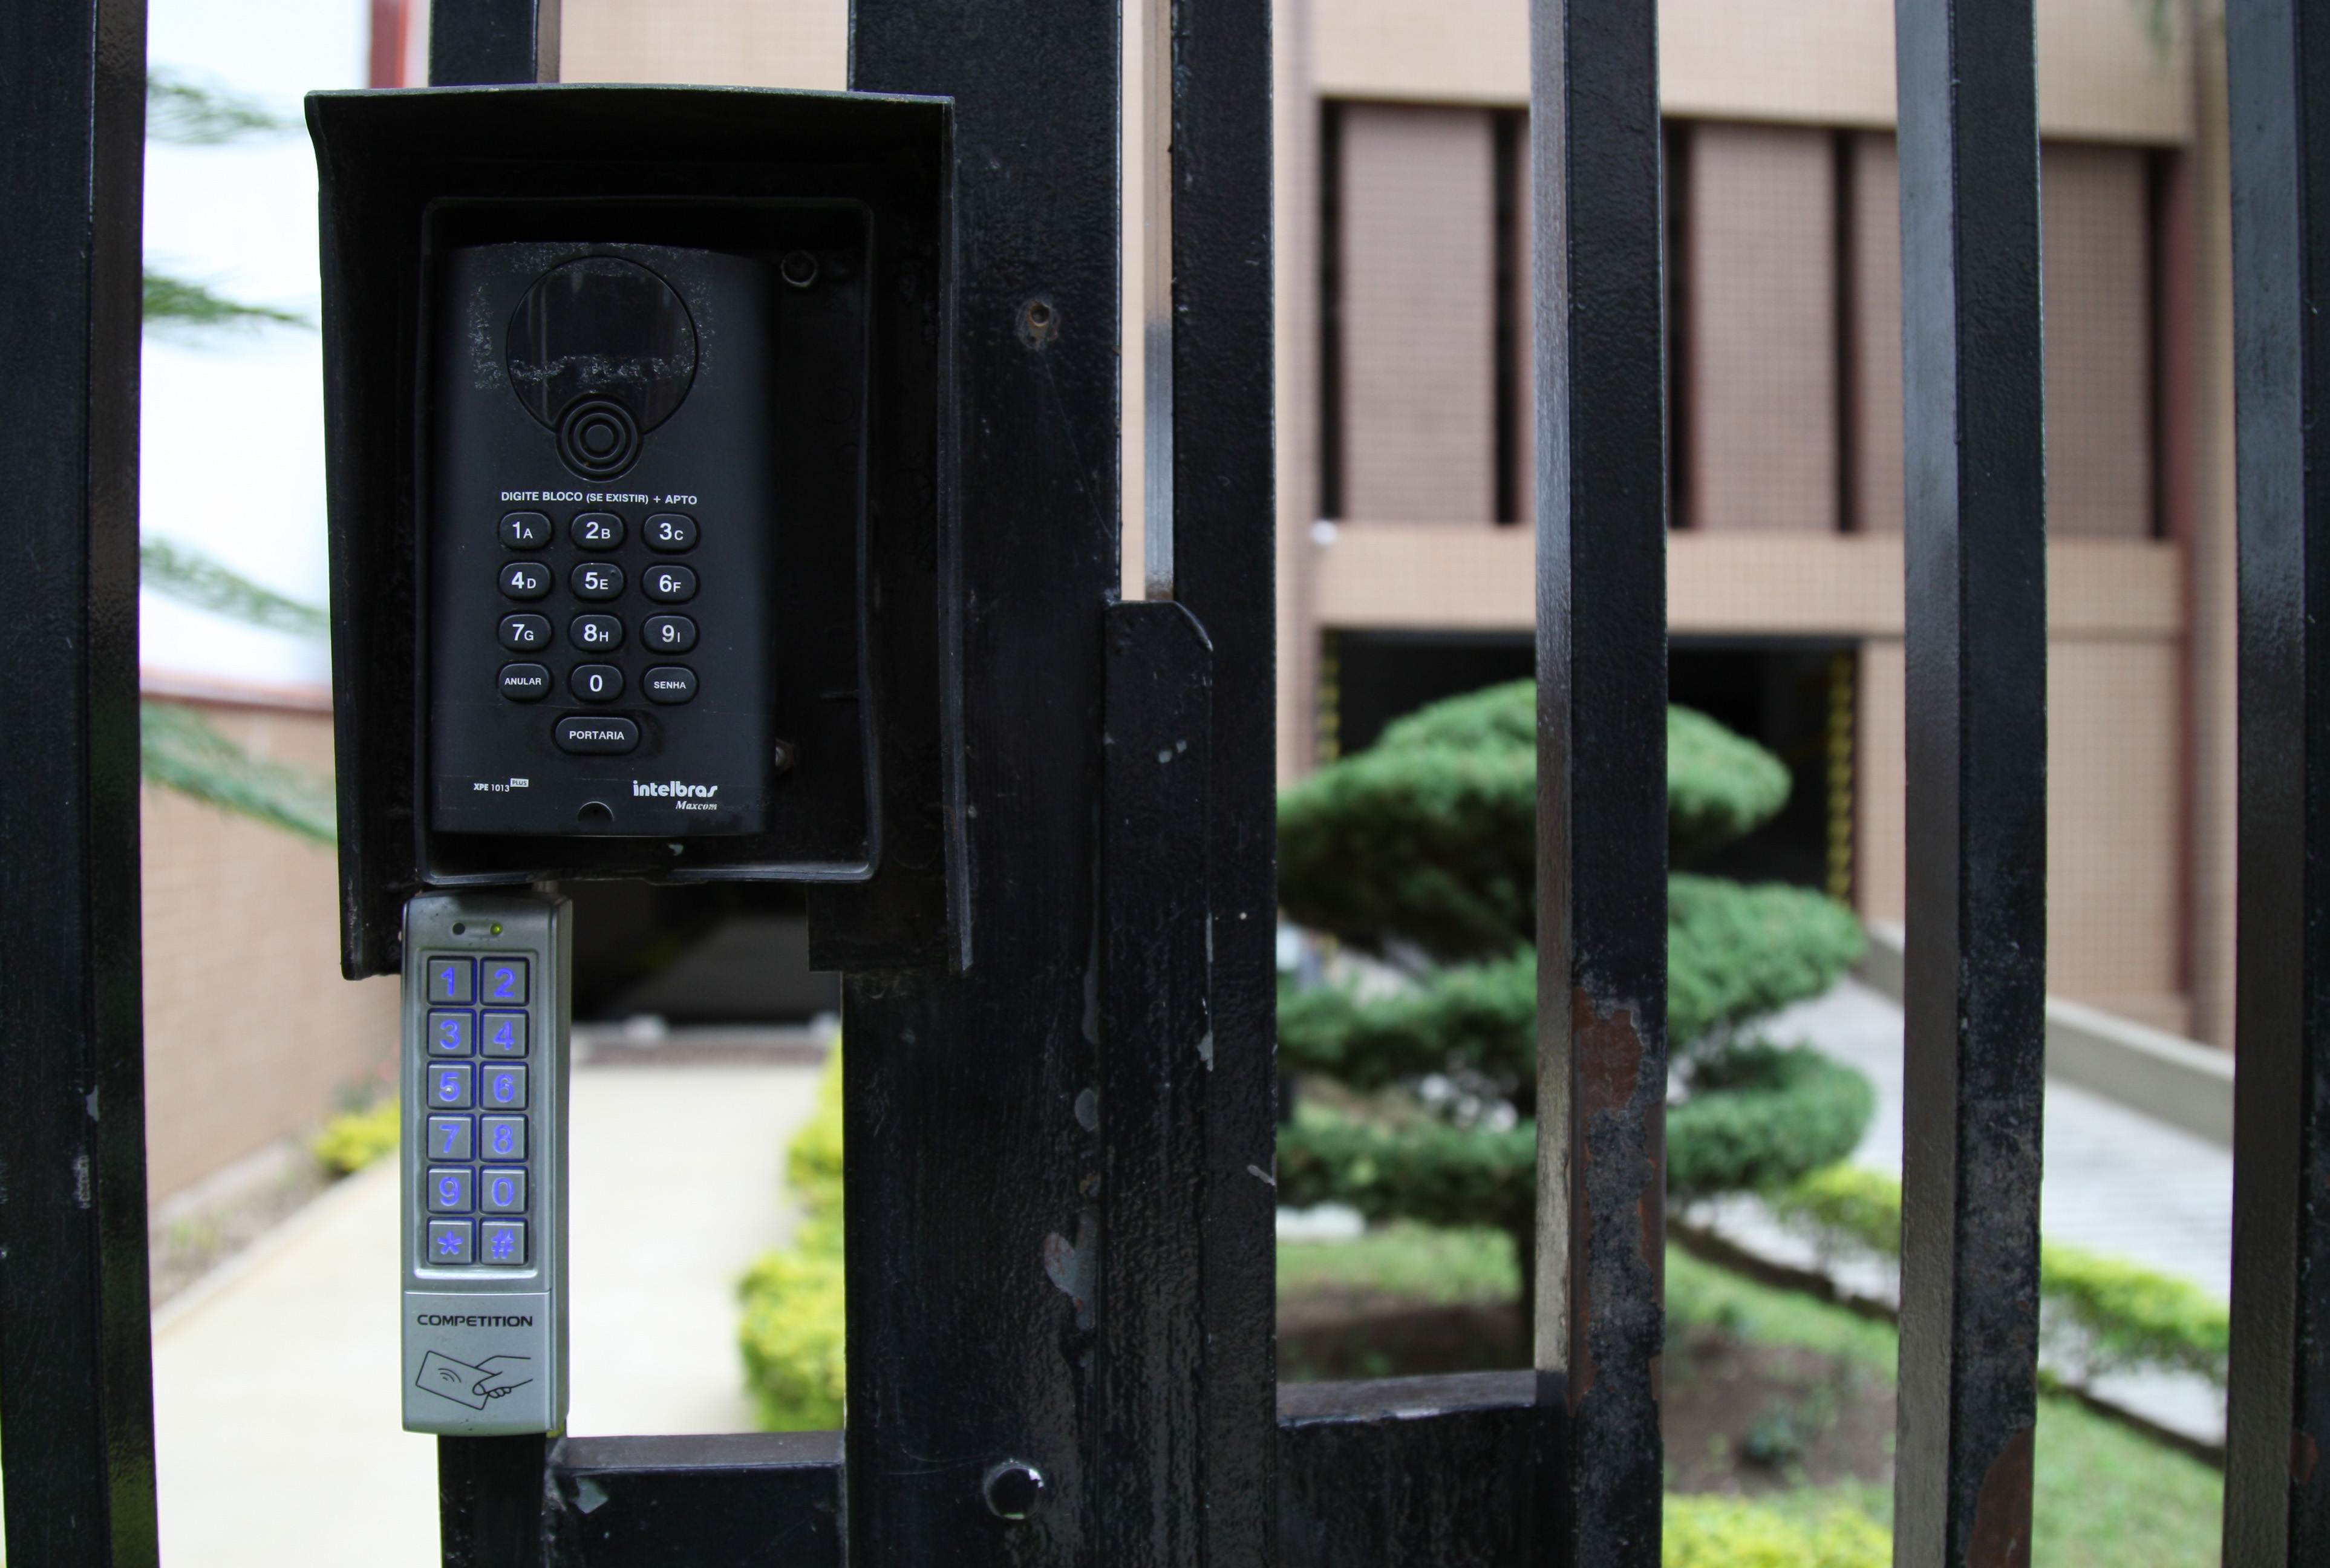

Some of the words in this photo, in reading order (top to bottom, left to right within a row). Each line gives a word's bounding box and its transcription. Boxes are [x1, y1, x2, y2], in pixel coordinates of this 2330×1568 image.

[501, 491, 540, 501] DIGITE
[542, 491, 583, 501] BLOCO
[586, 493, 603, 504] (SE
[605, 493, 649, 505] EXISTIR)
[665, 494, 697, 505] APTO
[504, 677, 541, 685] ANULAR
[590, 675, 603, 692] 0
[653, 681, 687, 689] SENHA
[569, 730, 625, 740] PORTARIA
[473, 783, 489, 791] XPE
[491, 783, 510, 792] 1013
[633, 780, 718, 798] intelbras
[675, 800, 717, 810] Maxcom
[440, 967, 455, 996] 1
[493, 967, 515, 998] 2
[440, 1019, 461, 1050] 3
[493, 1021, 515, 1050] 4
[439, 1071, 460, 1102] 5
[493, 1073, 515, 1102] 6
[439, 1124, 460, 1153] 7
[492, 1124, 514, 1153] 8
[439, 1177, 461, 1206] 9
[492, 1178, 514, 1206] 0
[417, 1315, 533, 1327] COMPETITION
